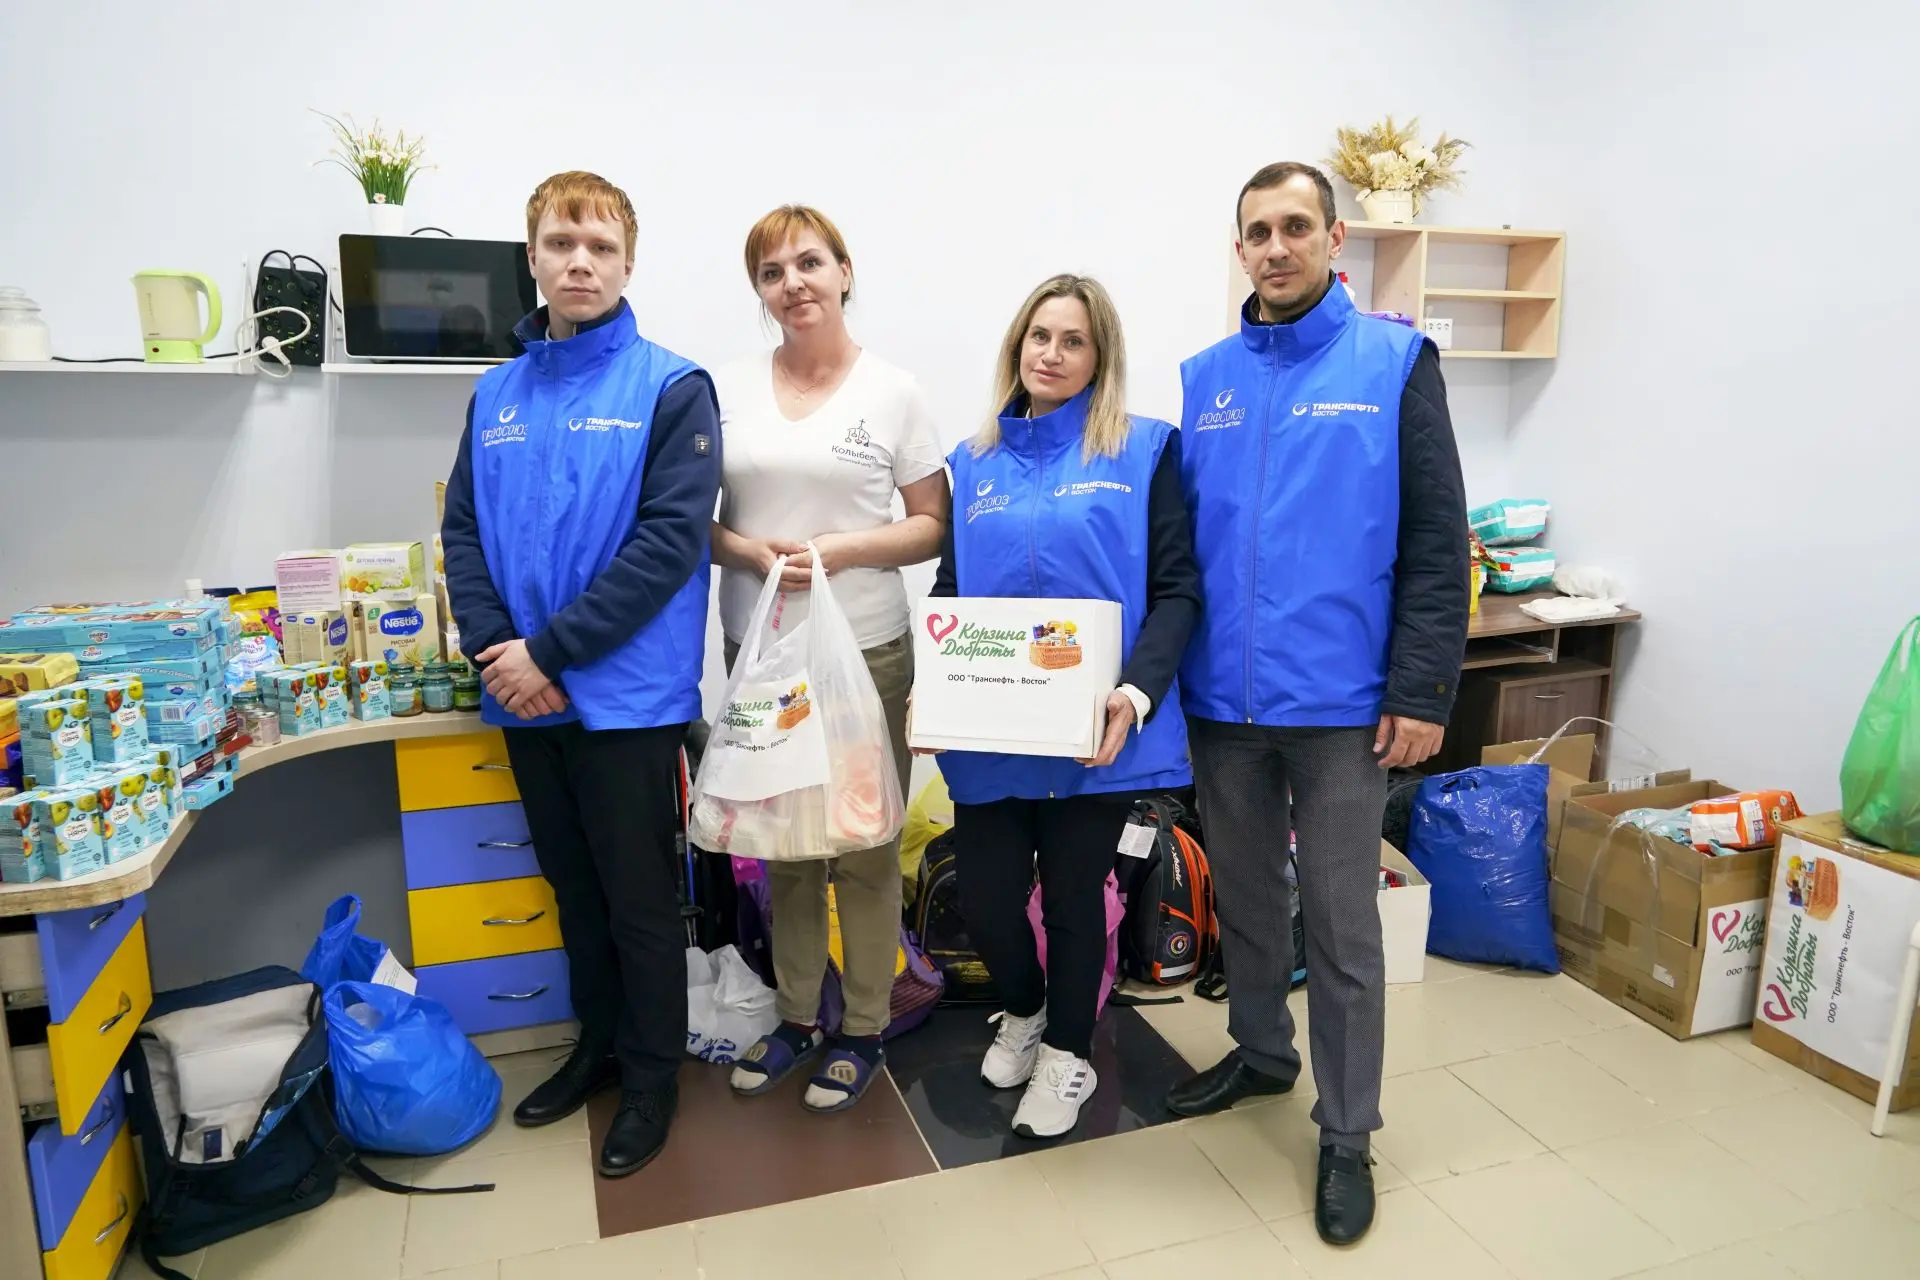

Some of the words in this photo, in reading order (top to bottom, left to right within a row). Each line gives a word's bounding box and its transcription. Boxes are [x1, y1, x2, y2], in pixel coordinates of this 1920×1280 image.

[1312, 403, 1379, 412] ТРАНСНЕФТЬ
[1072, 481, 1132, 493] ТРАНСНЕФТЬ
[958, 622, 1027, 642] Корзина
[941, 638, 1016, 661] Доброты
[947, 673, 965, 682] ООО
[967, 674, 1015, 684] "Транснефть
[1021, 677, 1051, 685] Восток"
[1842, 904, 1855, 940] Восток"
[1776, 913, 1802, 992] Корзина
[1726, 967, 1743, 977] ООО
[1790, 932, 1818, 1019] Доброты
[1831, 947, 1849, 1000] "Транснефть
[1827, 1002, 1838, 1024] ООО
